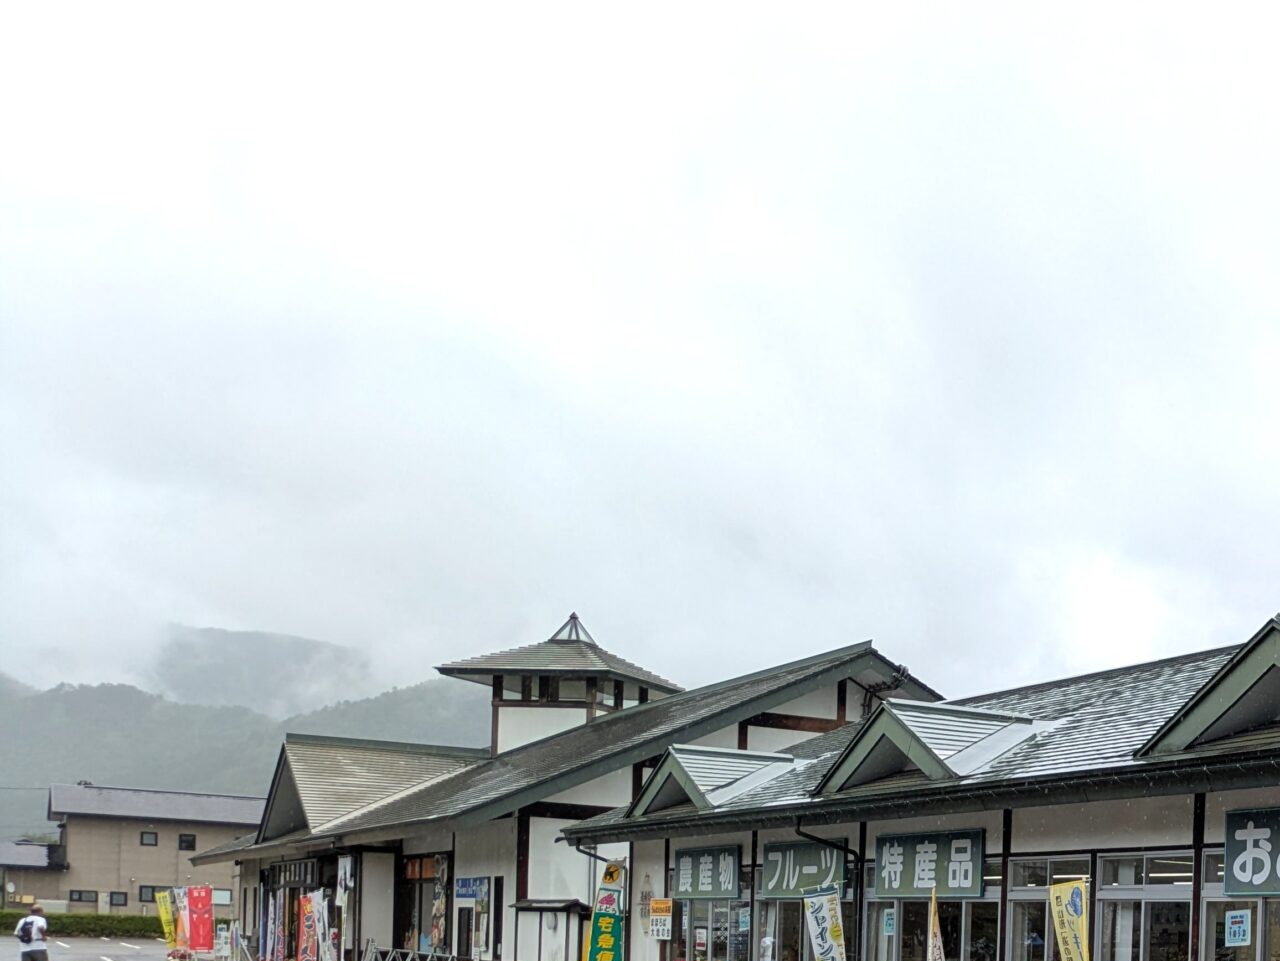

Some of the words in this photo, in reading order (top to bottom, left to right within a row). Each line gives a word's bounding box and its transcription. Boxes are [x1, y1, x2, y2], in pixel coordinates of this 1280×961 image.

[679, 852, 734, 893] 農産物
[767, 847, 838, 891] フルーツ
[882, 838, 974, 889] 特産品
